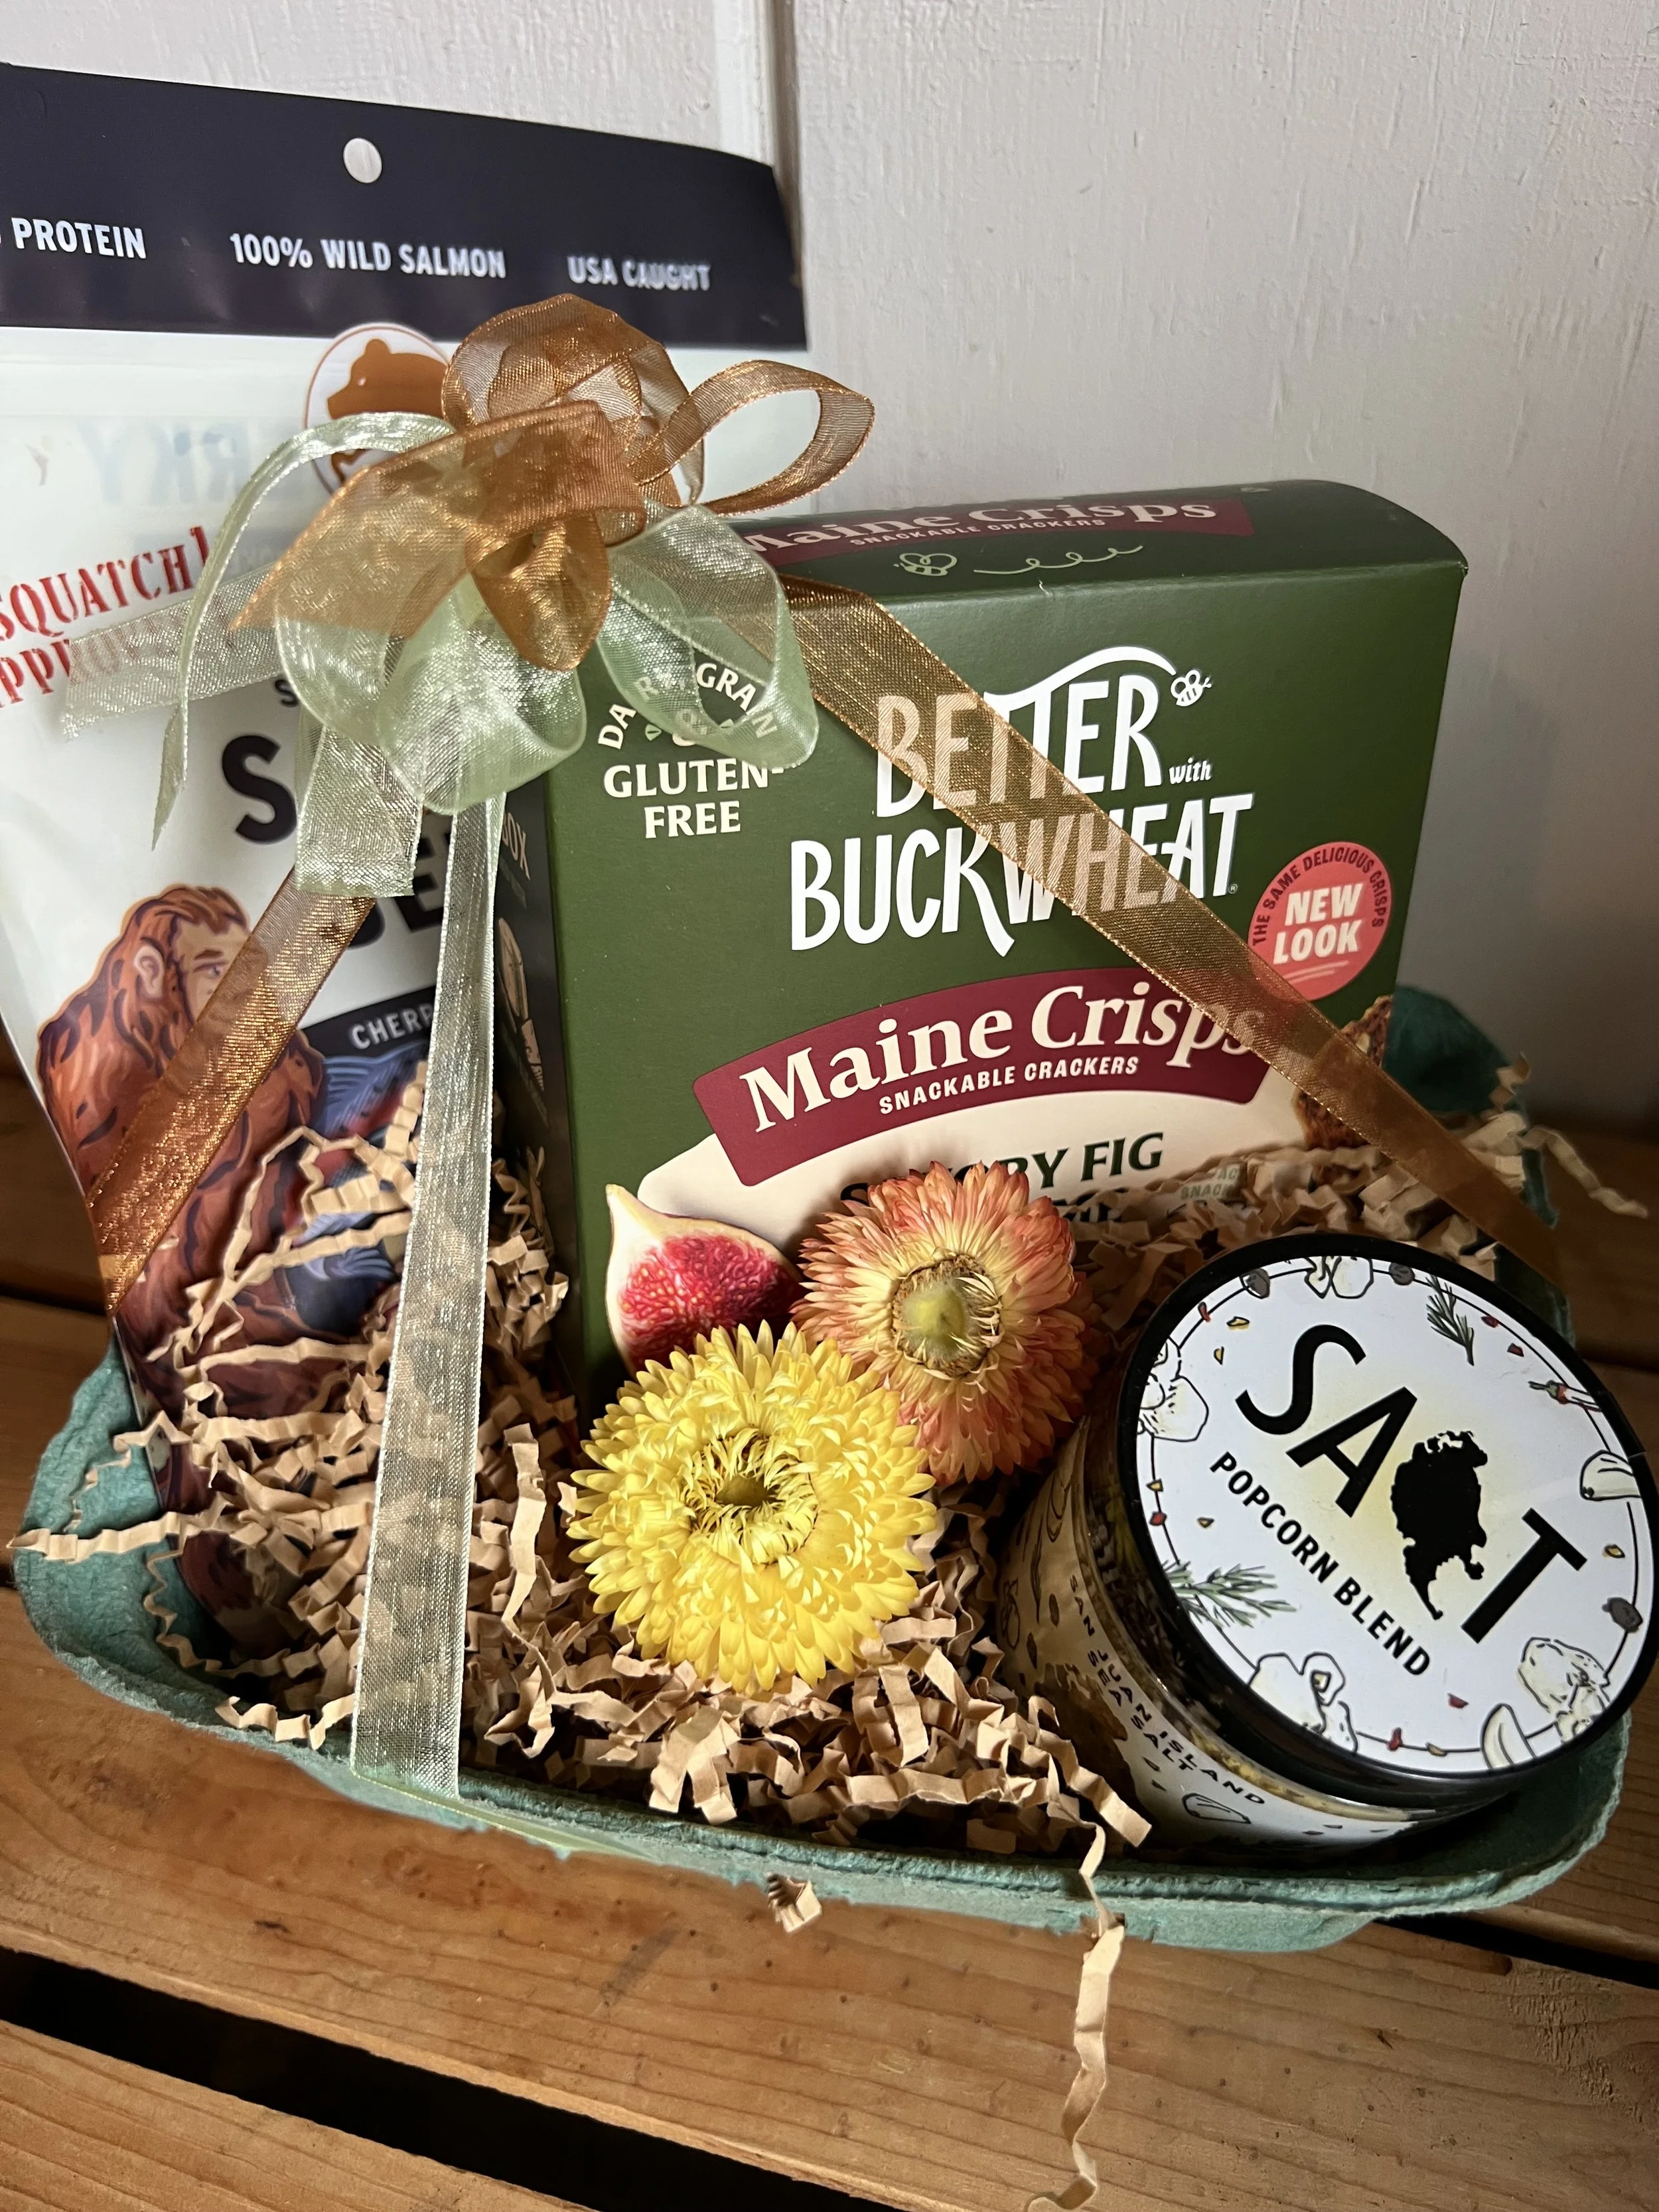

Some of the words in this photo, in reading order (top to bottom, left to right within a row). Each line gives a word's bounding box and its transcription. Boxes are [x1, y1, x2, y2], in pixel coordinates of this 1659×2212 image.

[11, 217, 147, 259] PROTEIN
[230, 233, 313, 269] 100%
[320, 239, 391, 271] WILD
[398, 243, 506, 279] SALMON
[567, 256, 618, 285] USA
[622, 259, 711, 291] CAUGHT
[849, 526, 982, 546] SNACKABLE
[987, 519, 1106, 532] CRACKERS
[968, 504, 1216, 523] Crisps
[876, 646, 1178, 818] BETTER
[1169, 759, 1212, 785] with
[644, 800, 741, 840] FREE
[790, 793, 1255, 958] BUCKWHEAT
[1254, 915, 1270, 945] THE
[1263, 865, 1301, 910] SAME
[1303, 847, 1374, 874] DELICIOUS
[1370, 870, 1388, 927] CRISPS
[1284, 882, 1364, 927] NEW
[1272, 919, 1363, 966] LOOK
[739, 1009, 1013, 1134] Maine
[1031, 981, 1265, 1069] Crisps
[879, 1066, 1015, 1116] SNACKABLE
[1023, 1056, 1139, 1082] CRACKERS
[1080, 1132, 1164, 1182] FIG
[1209, 1451, 1338, 1584] POPCORN
[1333, 1576, 1431, 1676] BLEND
[1069, 1575, 1095, 1637] SAN
[1159, 1730, 1265, 1805] ISLAND
[1086, 1649, 1123, 1706] SEA
[1130, 1714, 1194, 1771] SALT
